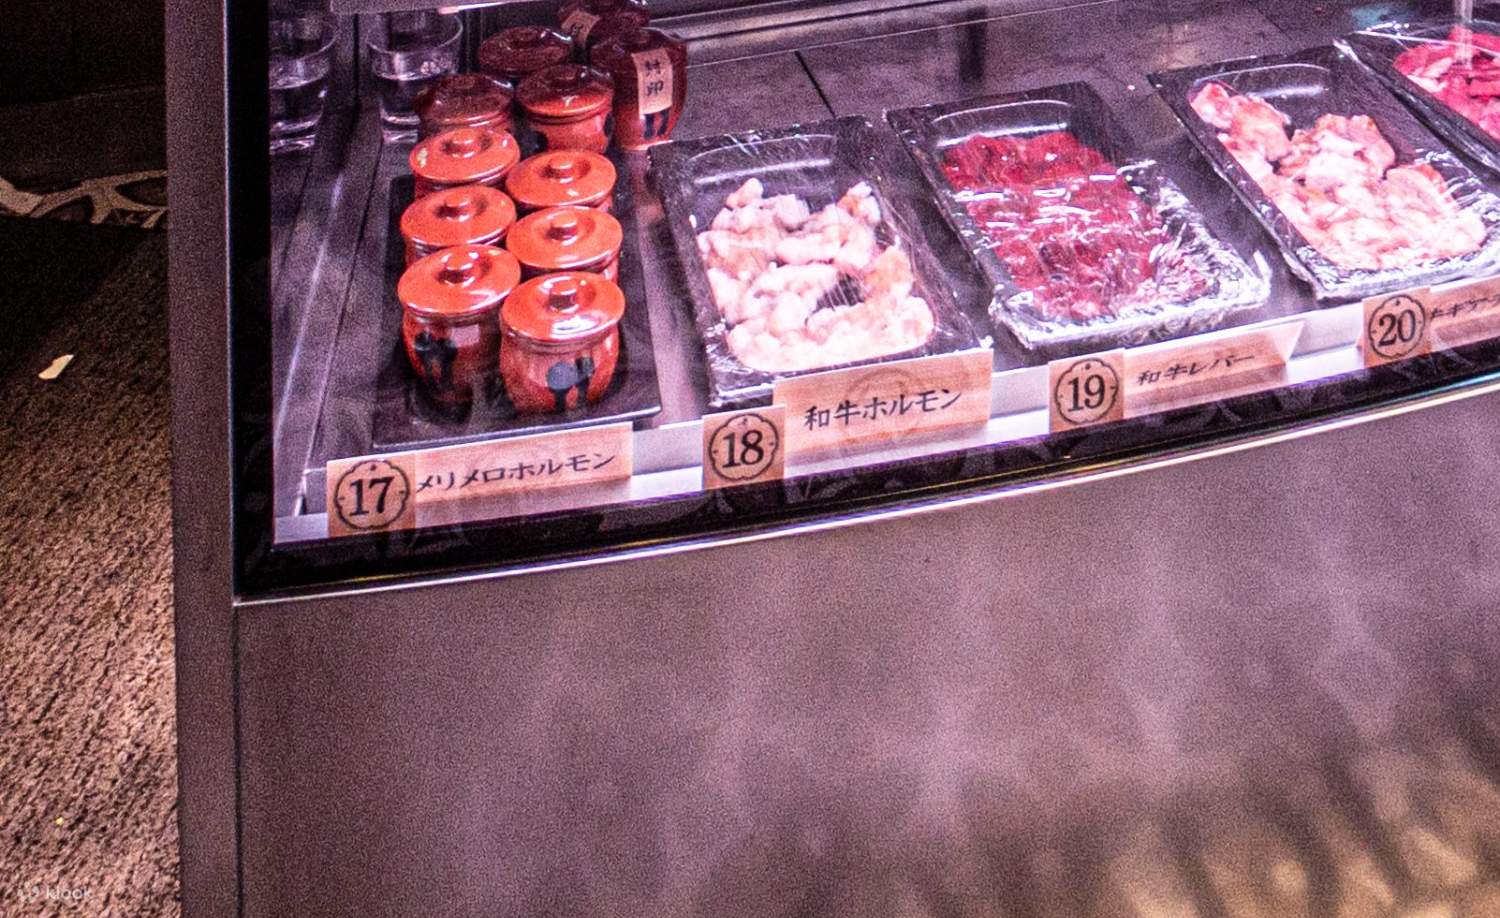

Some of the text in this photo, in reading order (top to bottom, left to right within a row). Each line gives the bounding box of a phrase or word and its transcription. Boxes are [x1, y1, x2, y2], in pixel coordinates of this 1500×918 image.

[1378, 308, 1417, 347] 20
[1067, 354, 1255, 412] 19 和牛レバー
[722, 388, 962, 468] 18 和牛ホルモン
[349, 452, 615, 516] 17 メリメロホルモン
